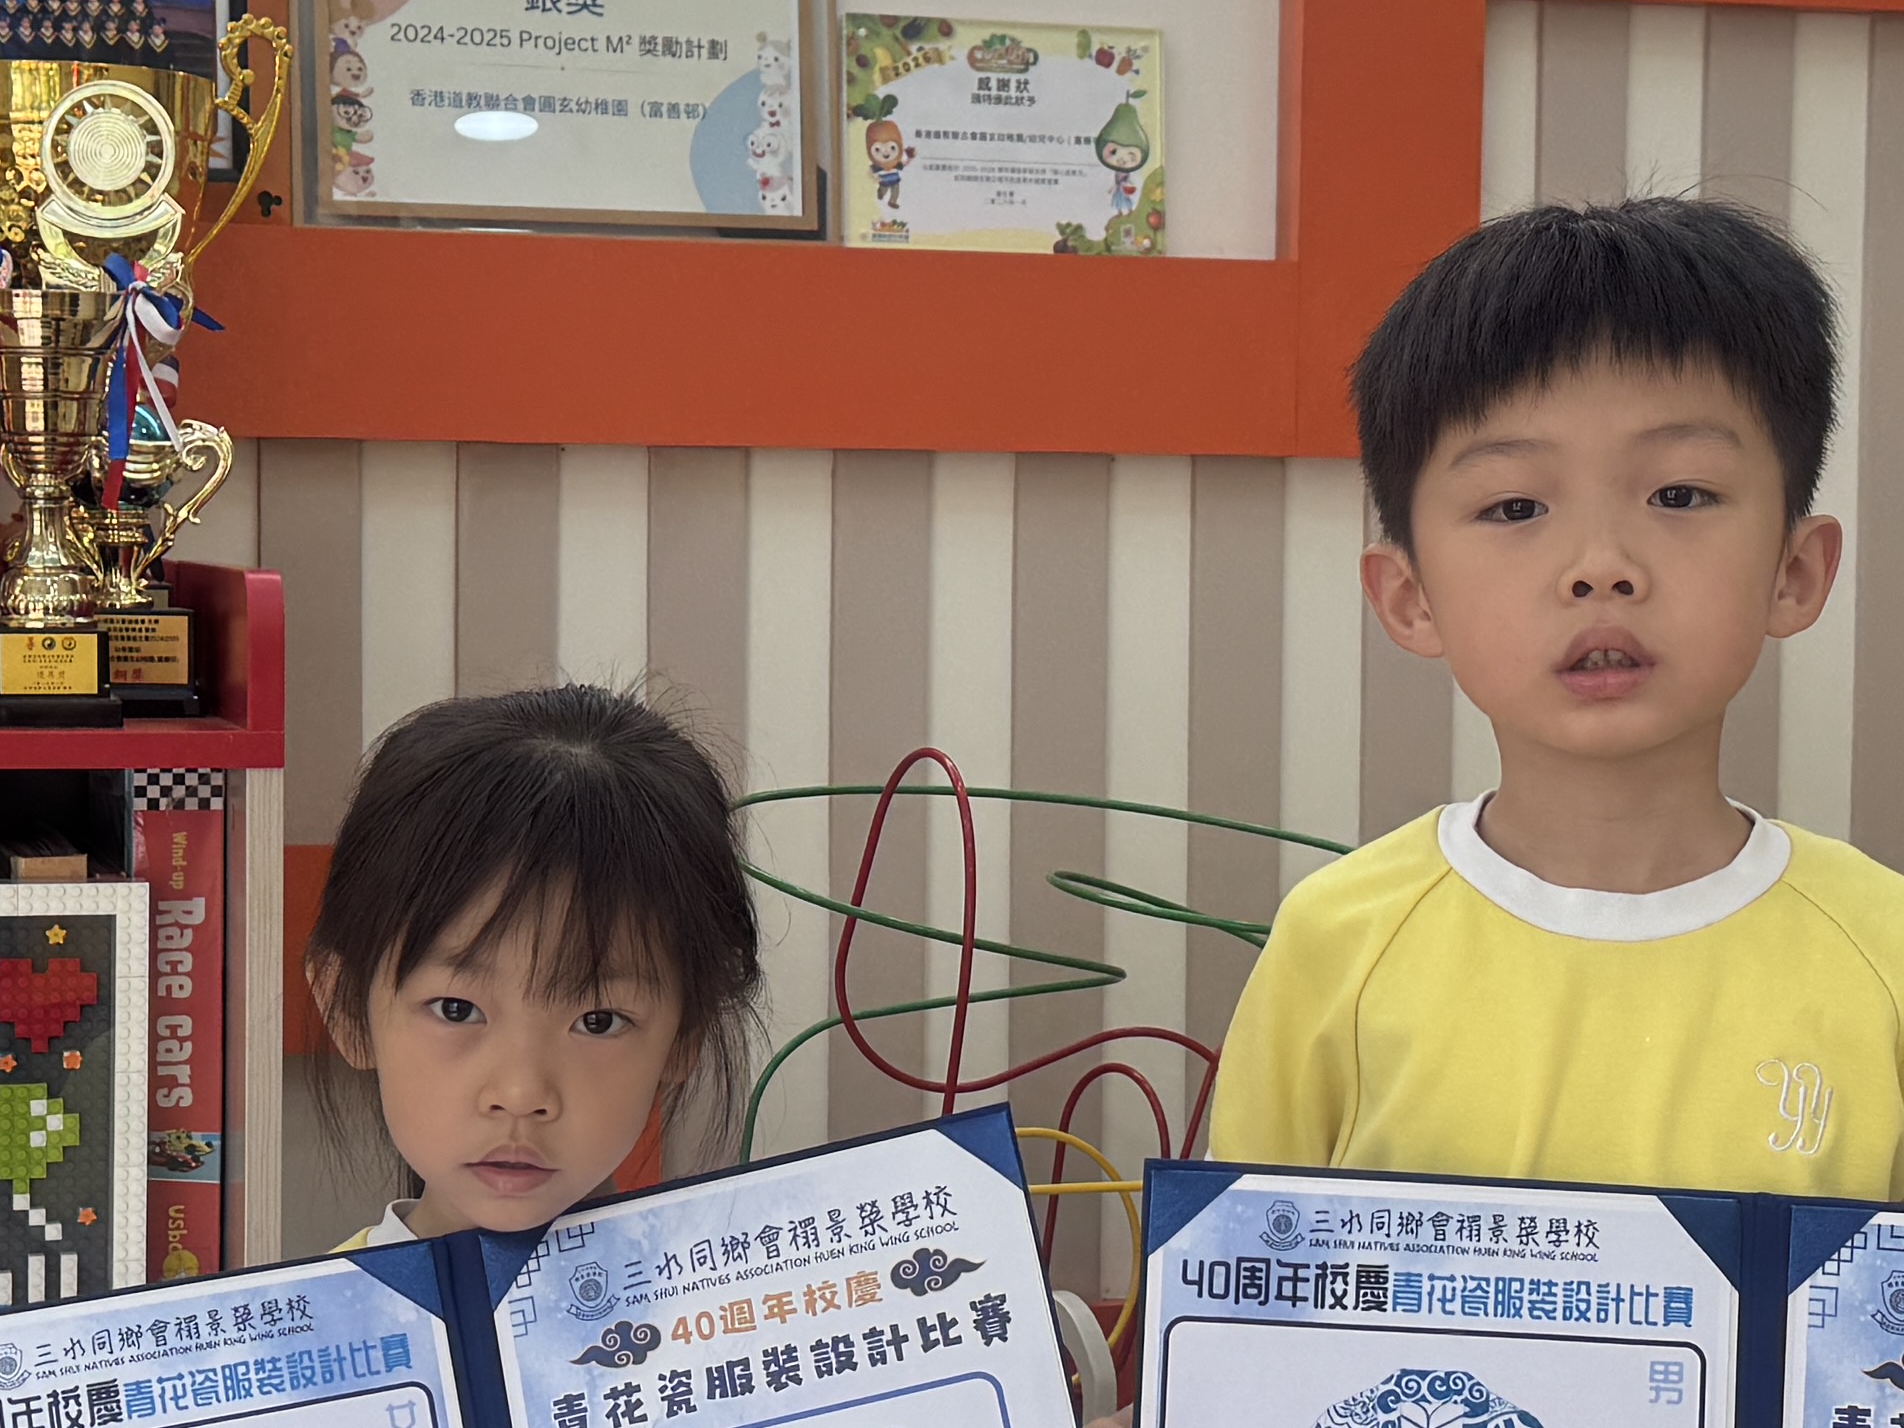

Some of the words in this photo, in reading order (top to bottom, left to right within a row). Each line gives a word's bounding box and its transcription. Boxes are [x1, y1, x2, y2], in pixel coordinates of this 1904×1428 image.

[389, 22, 512, 50] 2024-2025
[519, 29, 599, 57] Project
[638, 35, 729, 62] 獎勵計劃
[167, 830, 189, 891] Wind-up
[154, 897, 206, 999] Race
[154, 1013, 194, 1109] cars
[670, 1270, 885, 1346] 40週年校慶
